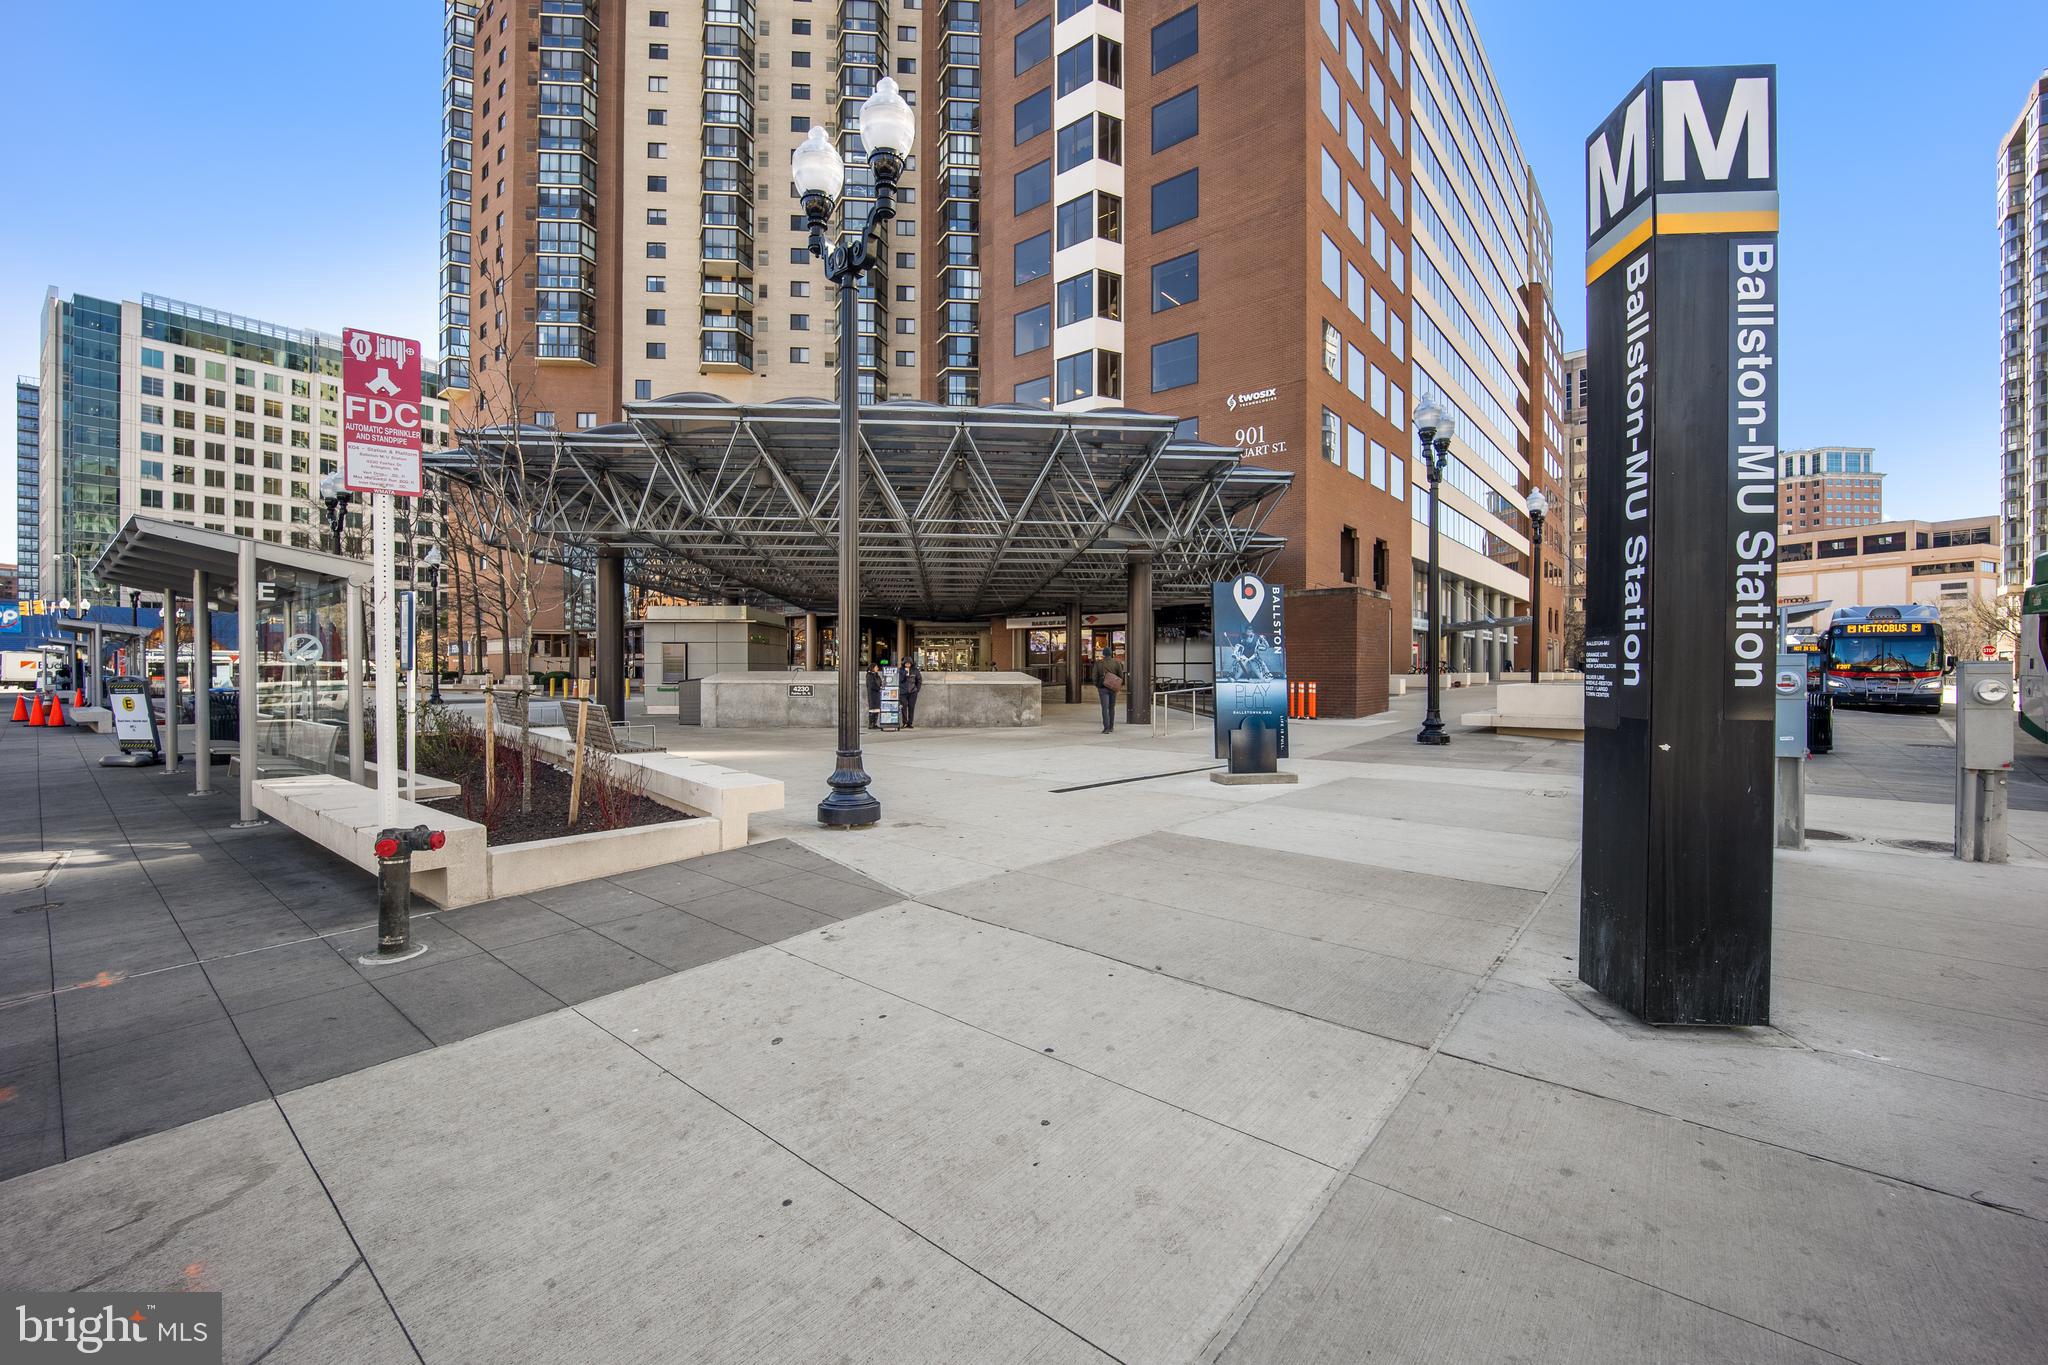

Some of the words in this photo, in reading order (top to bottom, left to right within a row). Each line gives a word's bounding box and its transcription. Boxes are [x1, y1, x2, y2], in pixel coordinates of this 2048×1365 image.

[1662, 78, 1769, 181] M
[1589, 88, 1647, 236] M
[1625, 252, 1649, 521] Ballston-MU
[1736, 244, 1775, 514] Ballston-MU
[1238, 388, 1276, 402] twosix
[346, 395, 418, 428] FDC
[346, 422, 383, 434] AUTOMATIC
[384, 428, 420, 439] SPRINKLER
[372, 434, 407, 445] STANDPIPE
[1235, 426, 1265, 447] 901
[1272, 442, 1287, 453] ST.
[257, 582, 276, 601] E
[1623, 535, 1648, 686] Station
[1734, 530, 1775, 687] Station
[1272, 587, 1282, 654] BALLSTON
[1858, 624, 1907, 633] METROBUS
[1236, 684, 1270, 696] PLAY
[125, 700, 132, 708] E
[1236, 696, 1271, 709] FULL
